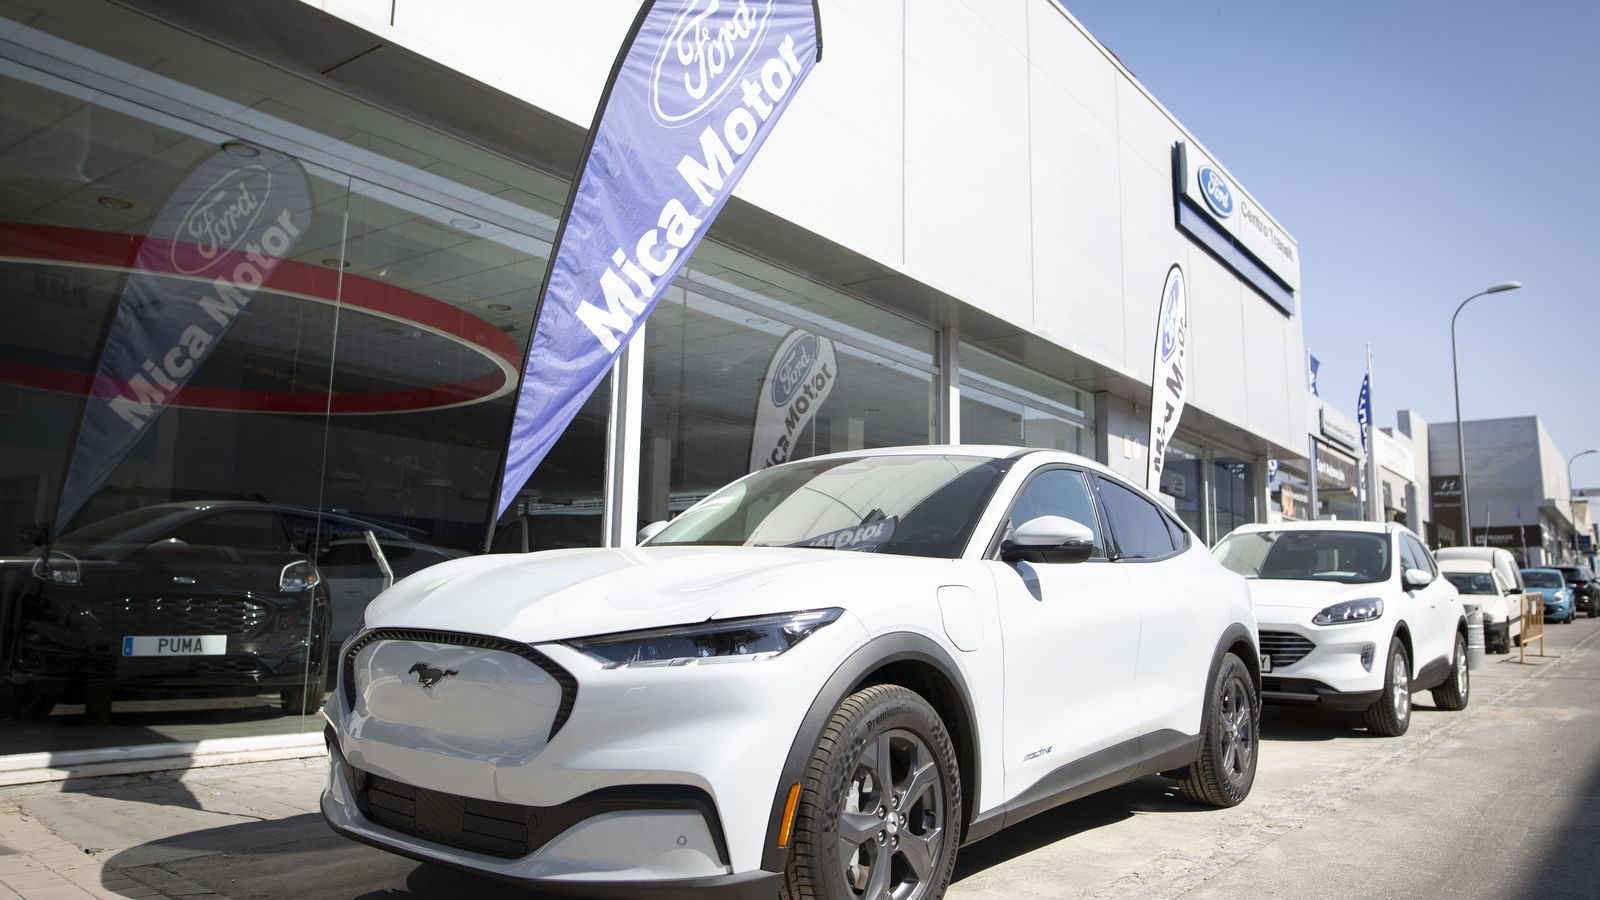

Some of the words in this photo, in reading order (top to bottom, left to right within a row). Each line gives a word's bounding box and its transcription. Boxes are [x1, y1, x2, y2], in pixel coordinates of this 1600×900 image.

[677, 0, 757, 99] Ford
[188, 181, 259, 258] Ford
[575, 198, 702, 354] Mica
[677, 33, 803, 207] Motor
[1207, 171, 1230, 209] Ford
[1241, 200, 1269, 238] Centro
[109, 325, 213, 430] Mica
[200, 210, 300, 329] Motor
[780, 345, 811, 395] Ford
[785, 362, 833, 437] Motor
[158, 638, 203, 653] PUMA
